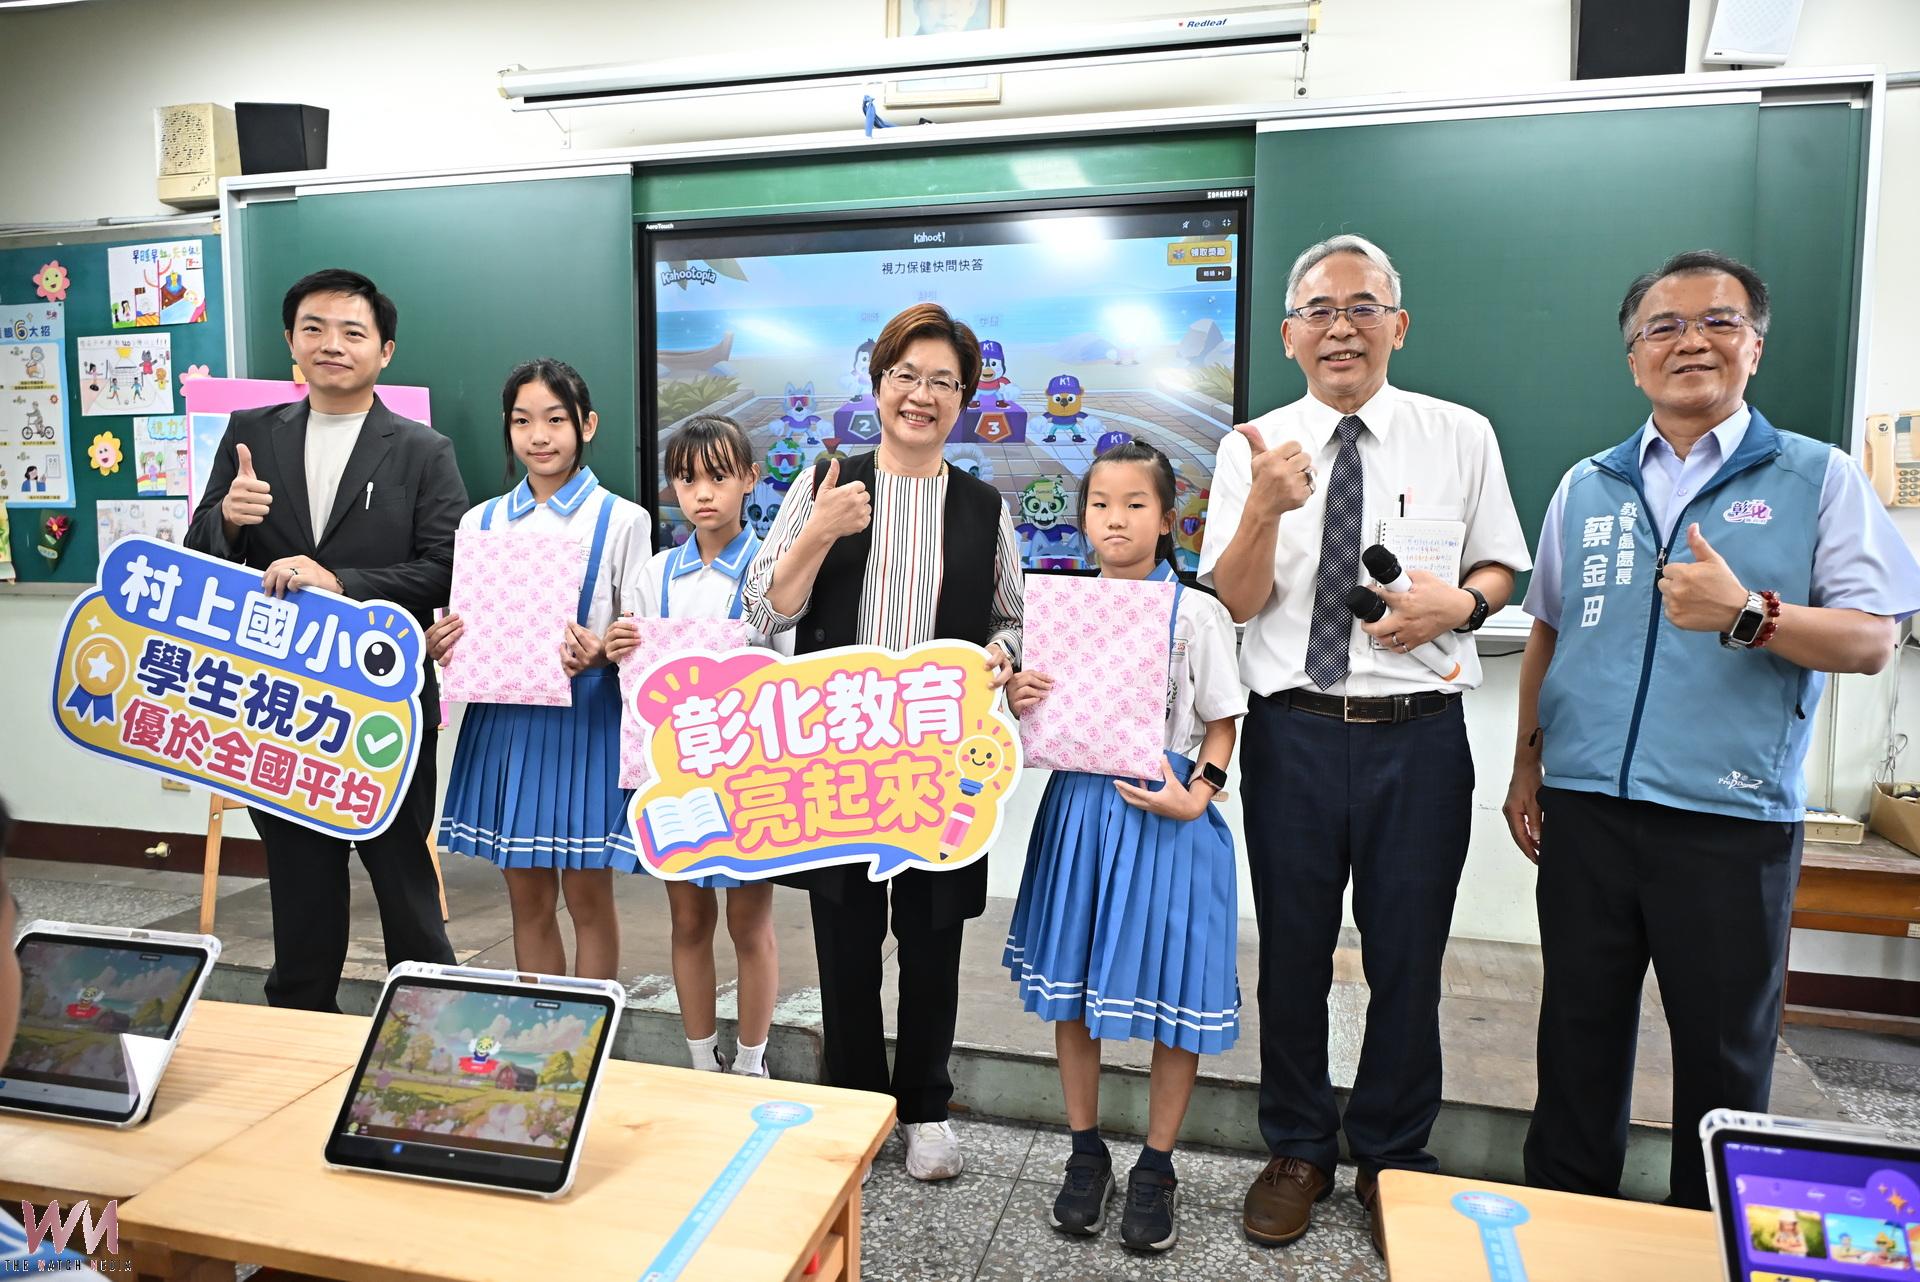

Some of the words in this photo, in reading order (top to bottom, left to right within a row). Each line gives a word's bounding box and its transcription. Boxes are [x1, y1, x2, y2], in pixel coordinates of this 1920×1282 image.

[1187, 18, 1228, 28] Redleaf
[913, 231, 946, 243] Kahoot!
[661, 266, 717, 286] Kahootopia
[882, 258, 984, 275] 視力保健快問快答
[1059, 376, 1071, 387] K!
[859, 420, 871, 432] 2
[987, 421, 1000, 436] 3
[1616, 502, 1638, 585] 教育處處長
[1581, 514, 1614, 627] 蔡金田
[120, 555, 352, 673] 村上國小
[137, 639, 352, 753] 學生視力
[673, 664, 963, 774] 彰化教育
[121, 699, 382, 825] 優於全國平均
[730, 756, 939, 849] 亮起來
